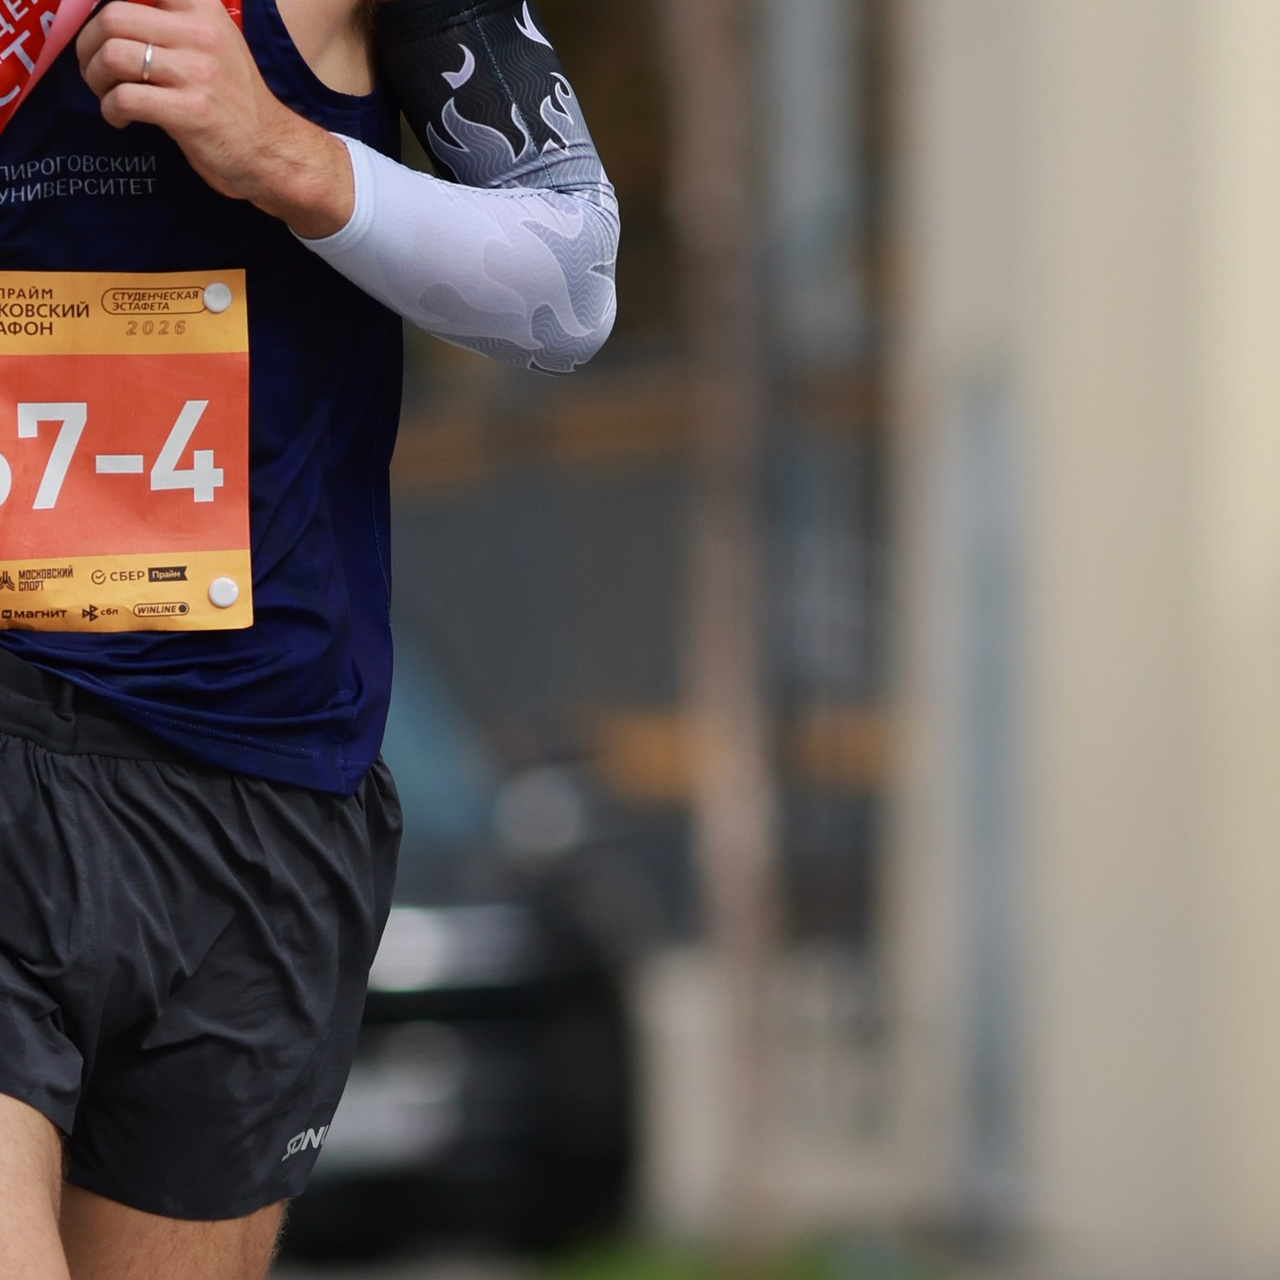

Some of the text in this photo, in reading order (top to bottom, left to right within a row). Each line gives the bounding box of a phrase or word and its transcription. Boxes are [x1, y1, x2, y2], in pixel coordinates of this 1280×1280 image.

[111, 290, 199, 302] СТУДЕНЧЕСКАЯ
[111, 301, 170, 311] ЭСТАФЕТА
[125, 319, 187, 336] 2026
[18, 565, 74, 580] МОСКОВСКИЙ
[109, 569, 181, 582] СБЕР Прайм
[18, 580, 45, 592] СПОРТ
[100, 607, 119, 616] сбп
[137, 605, 177, 615] WINLINE
